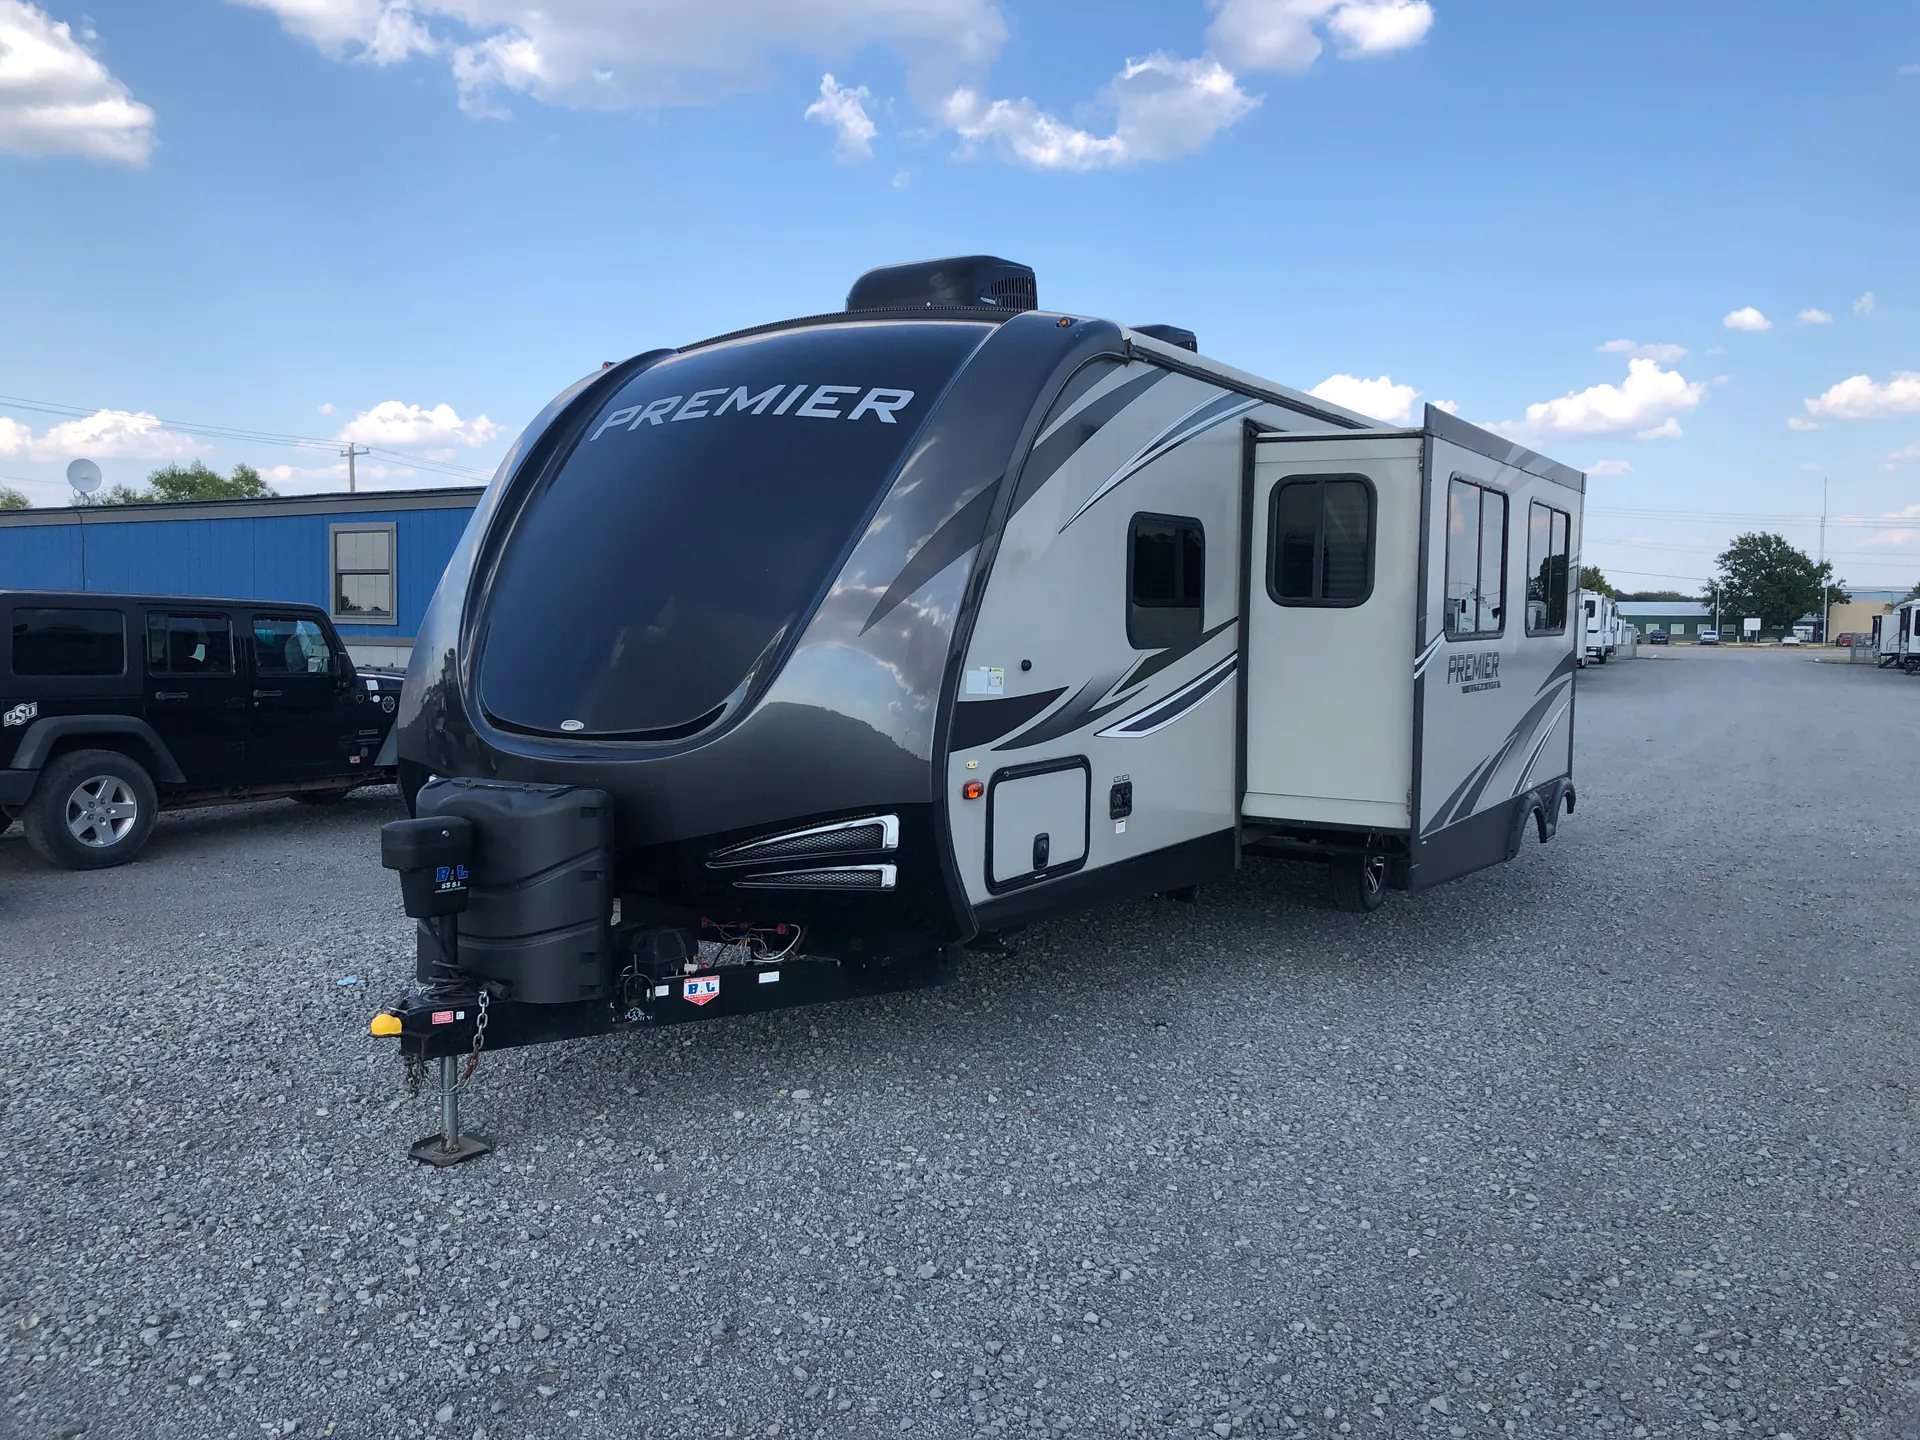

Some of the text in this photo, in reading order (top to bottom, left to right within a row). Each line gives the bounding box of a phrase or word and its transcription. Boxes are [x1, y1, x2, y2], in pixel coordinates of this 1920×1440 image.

[589, 384, 915, 441] PREMIER
[1447, 652, 1499, 684] PREMIER
[4, 702, 38, 727] OSU
